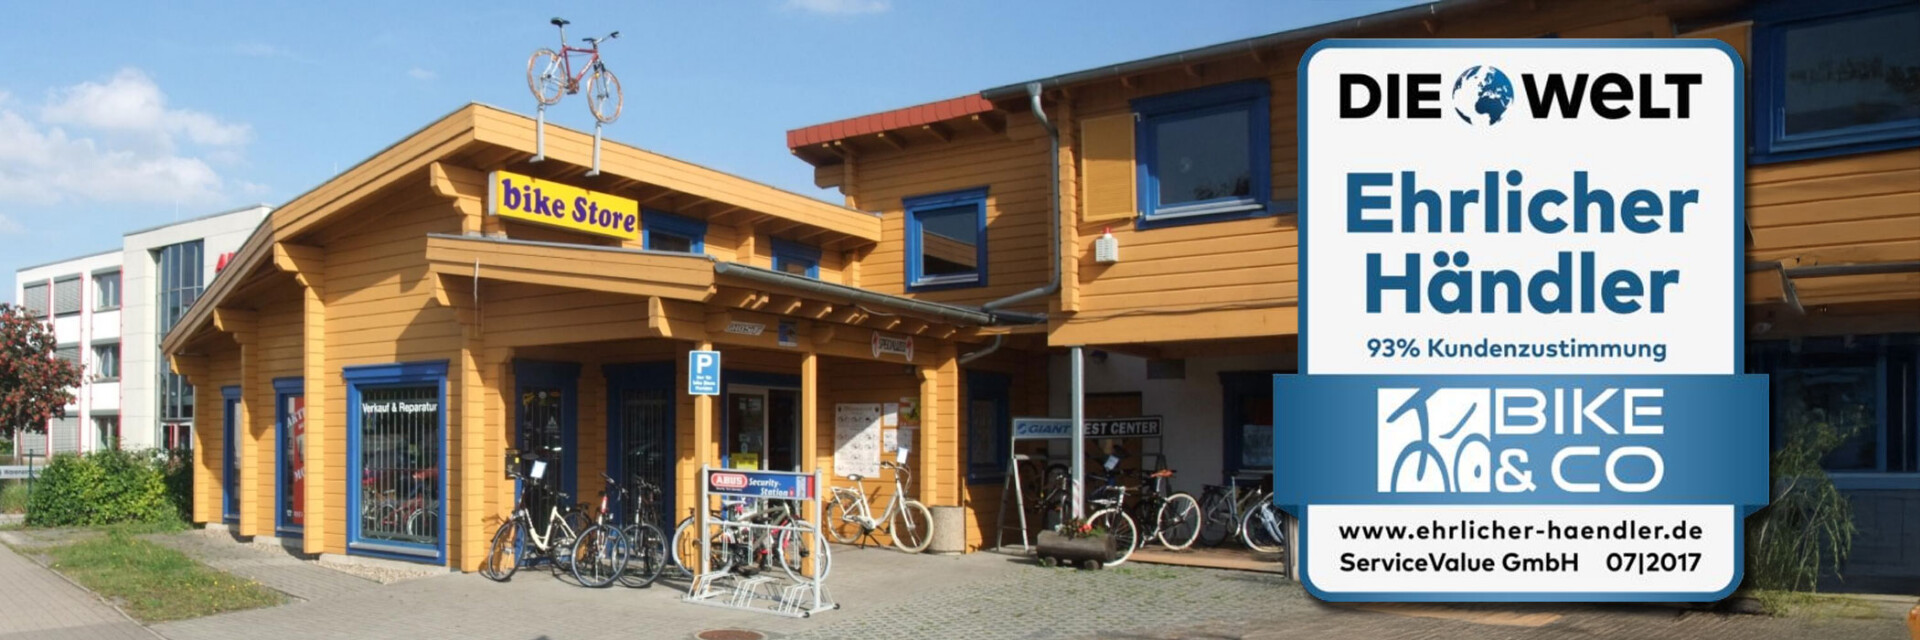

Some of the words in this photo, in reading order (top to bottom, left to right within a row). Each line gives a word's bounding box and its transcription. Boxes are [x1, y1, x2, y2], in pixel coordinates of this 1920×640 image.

[502, 178, 566, 219] bike
[572, 196, 636, 233] Store
[696, 354, 712, 374] P
[362, 402, 390, 414] Verkauf
[391, 402, 398, 413] &
[399, 401, 438, 414] Reparatur
[1028, 424, 1071, 434] GIANT
[1084, 422, 1106, 435] EST
[1110, 421, 1158, 434] CENTER
[716, 475, 743, 485] ABUS
[760, 488, 788, 497] Station
